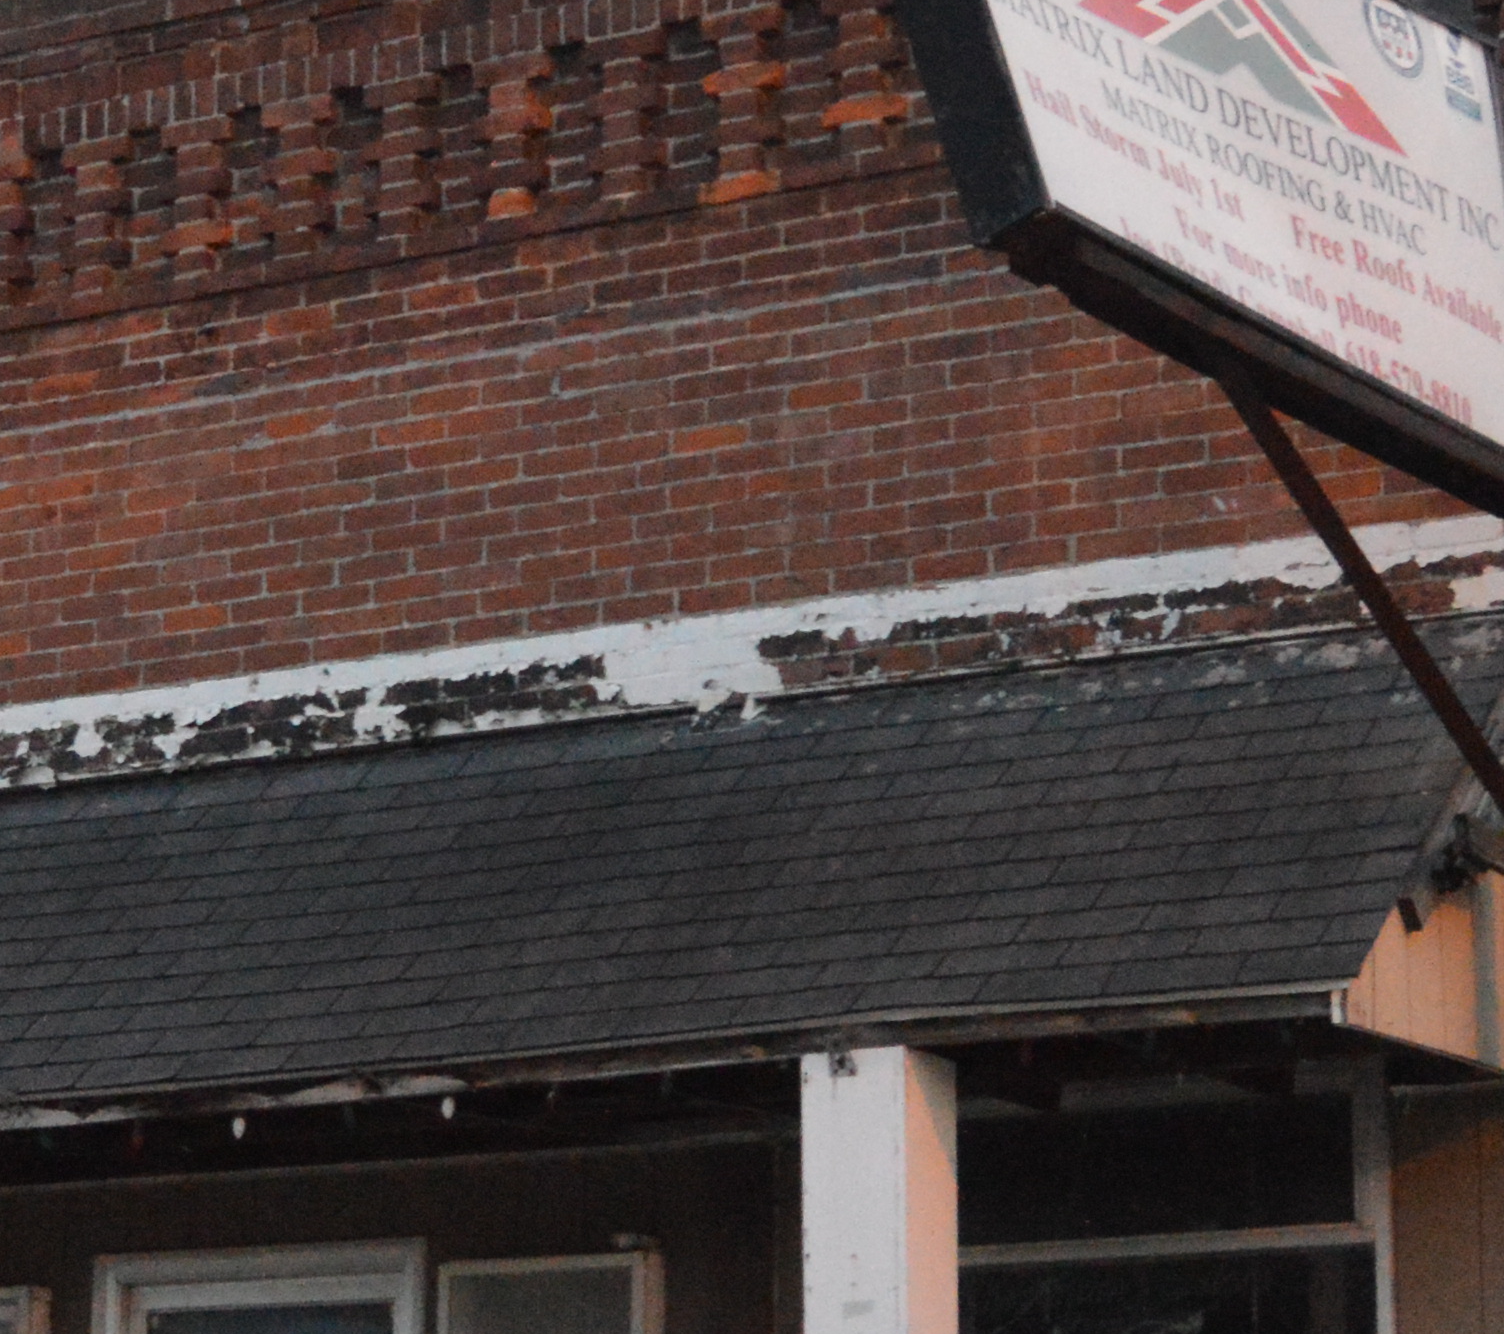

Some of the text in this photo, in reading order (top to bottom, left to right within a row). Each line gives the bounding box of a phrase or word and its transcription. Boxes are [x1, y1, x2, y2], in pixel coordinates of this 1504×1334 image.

[1023, 69, 1245, 221] Hail Storm July 1st
[1101, 78, 1427, 256] MATRIX ROOFING & HVAC
[1116, 38, 1209, 113] LAND
[1216, 86, 1449, 222] DEVELOPMENT
[1457, 196, 1500, 251] INC
[1173, 205, 1402, 344] For more info phone
[1290, 213, 1503, 343] Free Roofs Available
